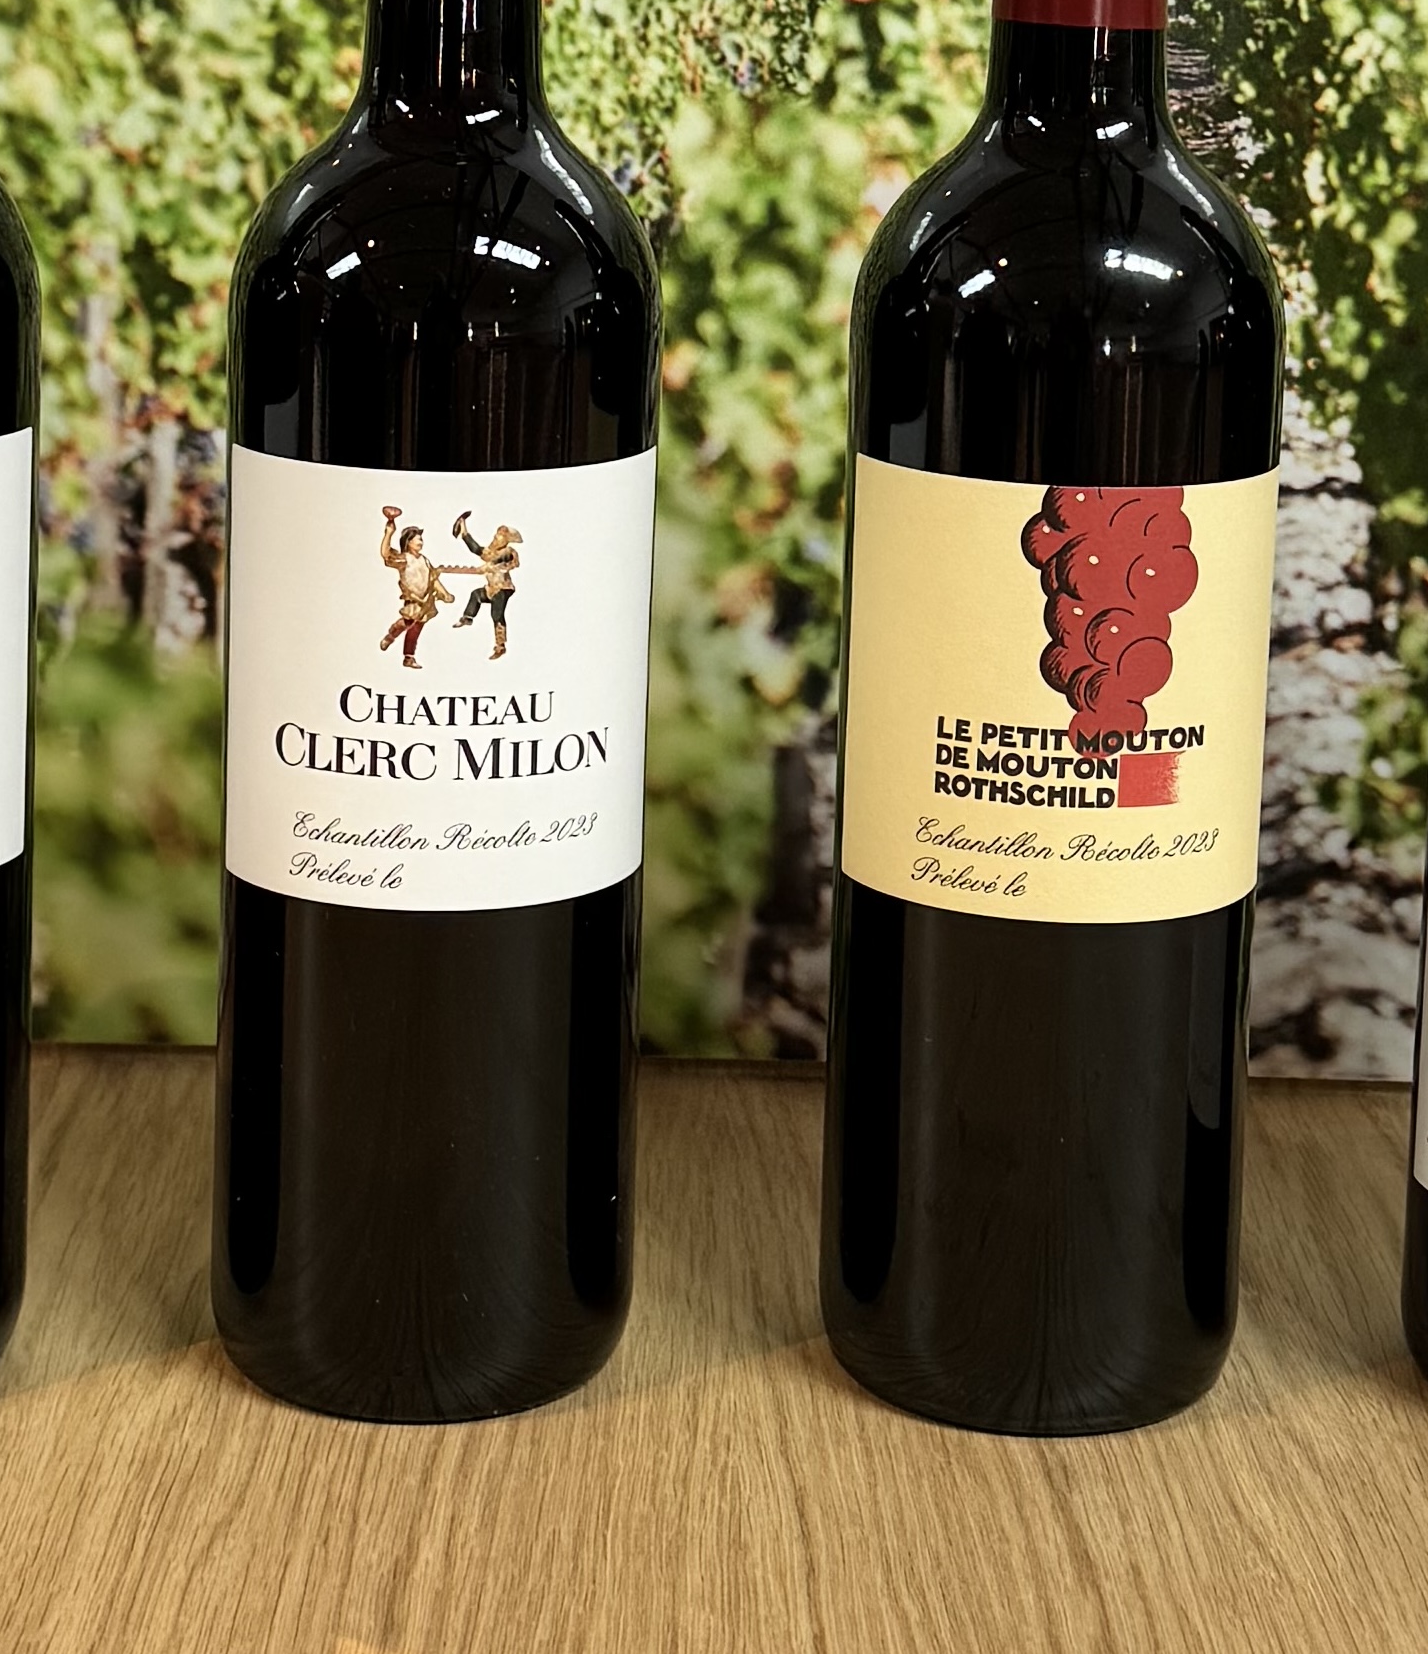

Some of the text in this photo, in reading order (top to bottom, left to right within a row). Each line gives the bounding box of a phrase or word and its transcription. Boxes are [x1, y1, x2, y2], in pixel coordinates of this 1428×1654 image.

[339, 683, 555, 727] CHATEAU
[274, 722, 610, 781] CLERC MILON
[937, 715, 1205, 755] LE PETIT MOUTON
[935, 743, 1119, 781] DE MOUTON
[934, 770, 1116, 809] ROTHSCHILD
[292, 809, 599, 851] Echantillon Récolte 2023
[914, 815, 1221, 862] Echantillon Récolte 2023
[288, 850, 404, 890] Prélevé le
[910, 856, 1028, 898] Prélevé le
